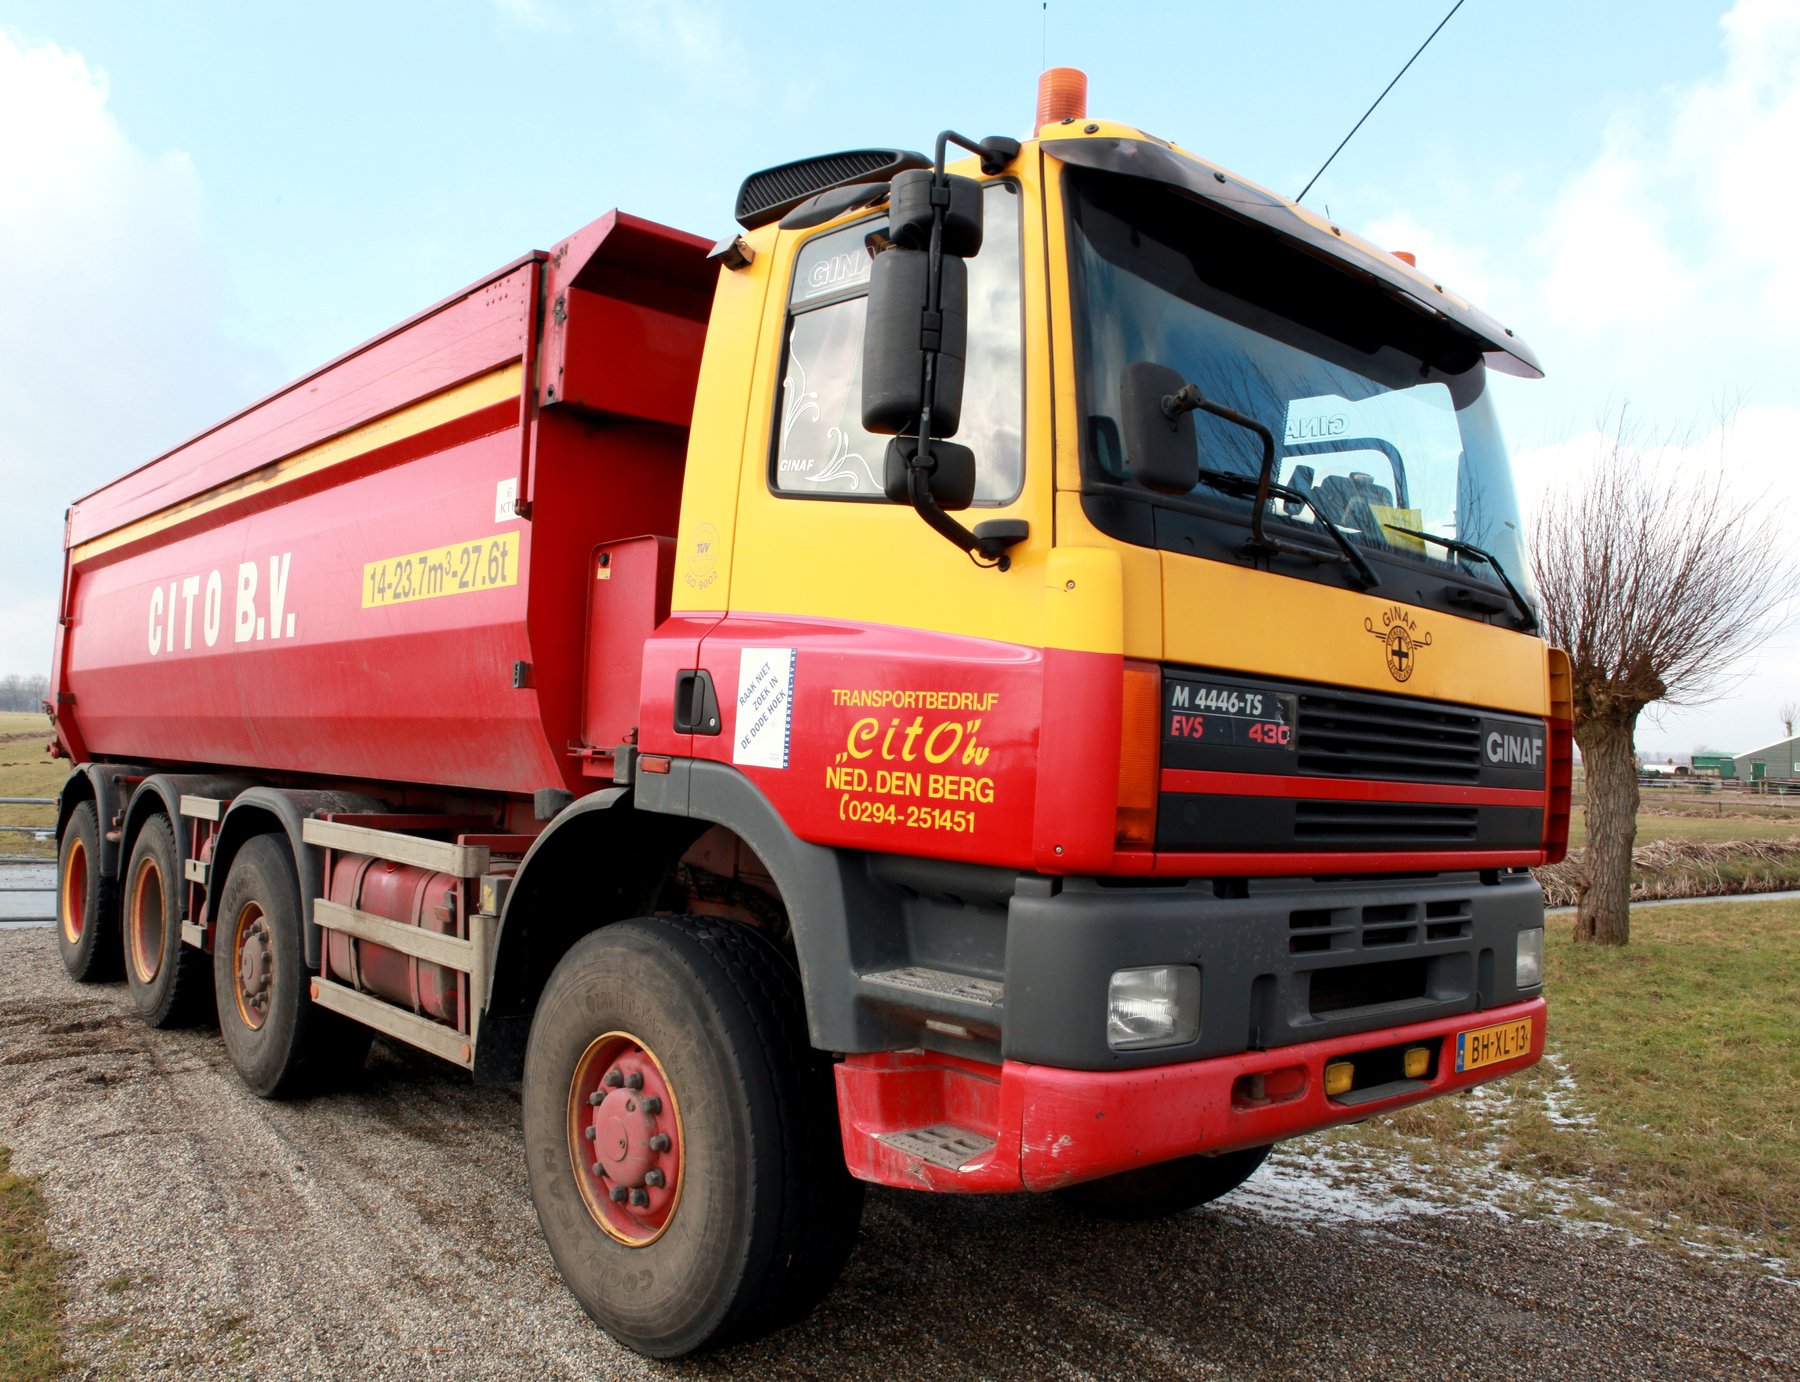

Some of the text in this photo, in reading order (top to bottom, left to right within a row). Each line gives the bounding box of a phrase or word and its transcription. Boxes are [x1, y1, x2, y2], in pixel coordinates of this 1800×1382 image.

[808, 245, 882, 287] GIN
[780, 459, 815, 471] GINAF
[148, 552, 296, 655] CITO B.V.
[1383, 606, 1417, 631] GINAF
[739, 661, 771, 706] RAAK NIET
[752, 676, 779, 711] ZOEK IN
[832, 689, 999, 711] TRANSPORTBEDRIJF
[1172, 685, 1263, 715] M 4446-TS
[740, 689, 787, 750] DE DODE HOEK
[1170, 715, 1290, 745] EVS 430
[1486, 731, 1543, 765] GINAF
[876, 770, 921, 796] DEN
[928, 775, 994, 803] BERG
[848, 800, 976, 833] 0294-251451
[1471, 1025, 1527, 1064] BH-XL-13
